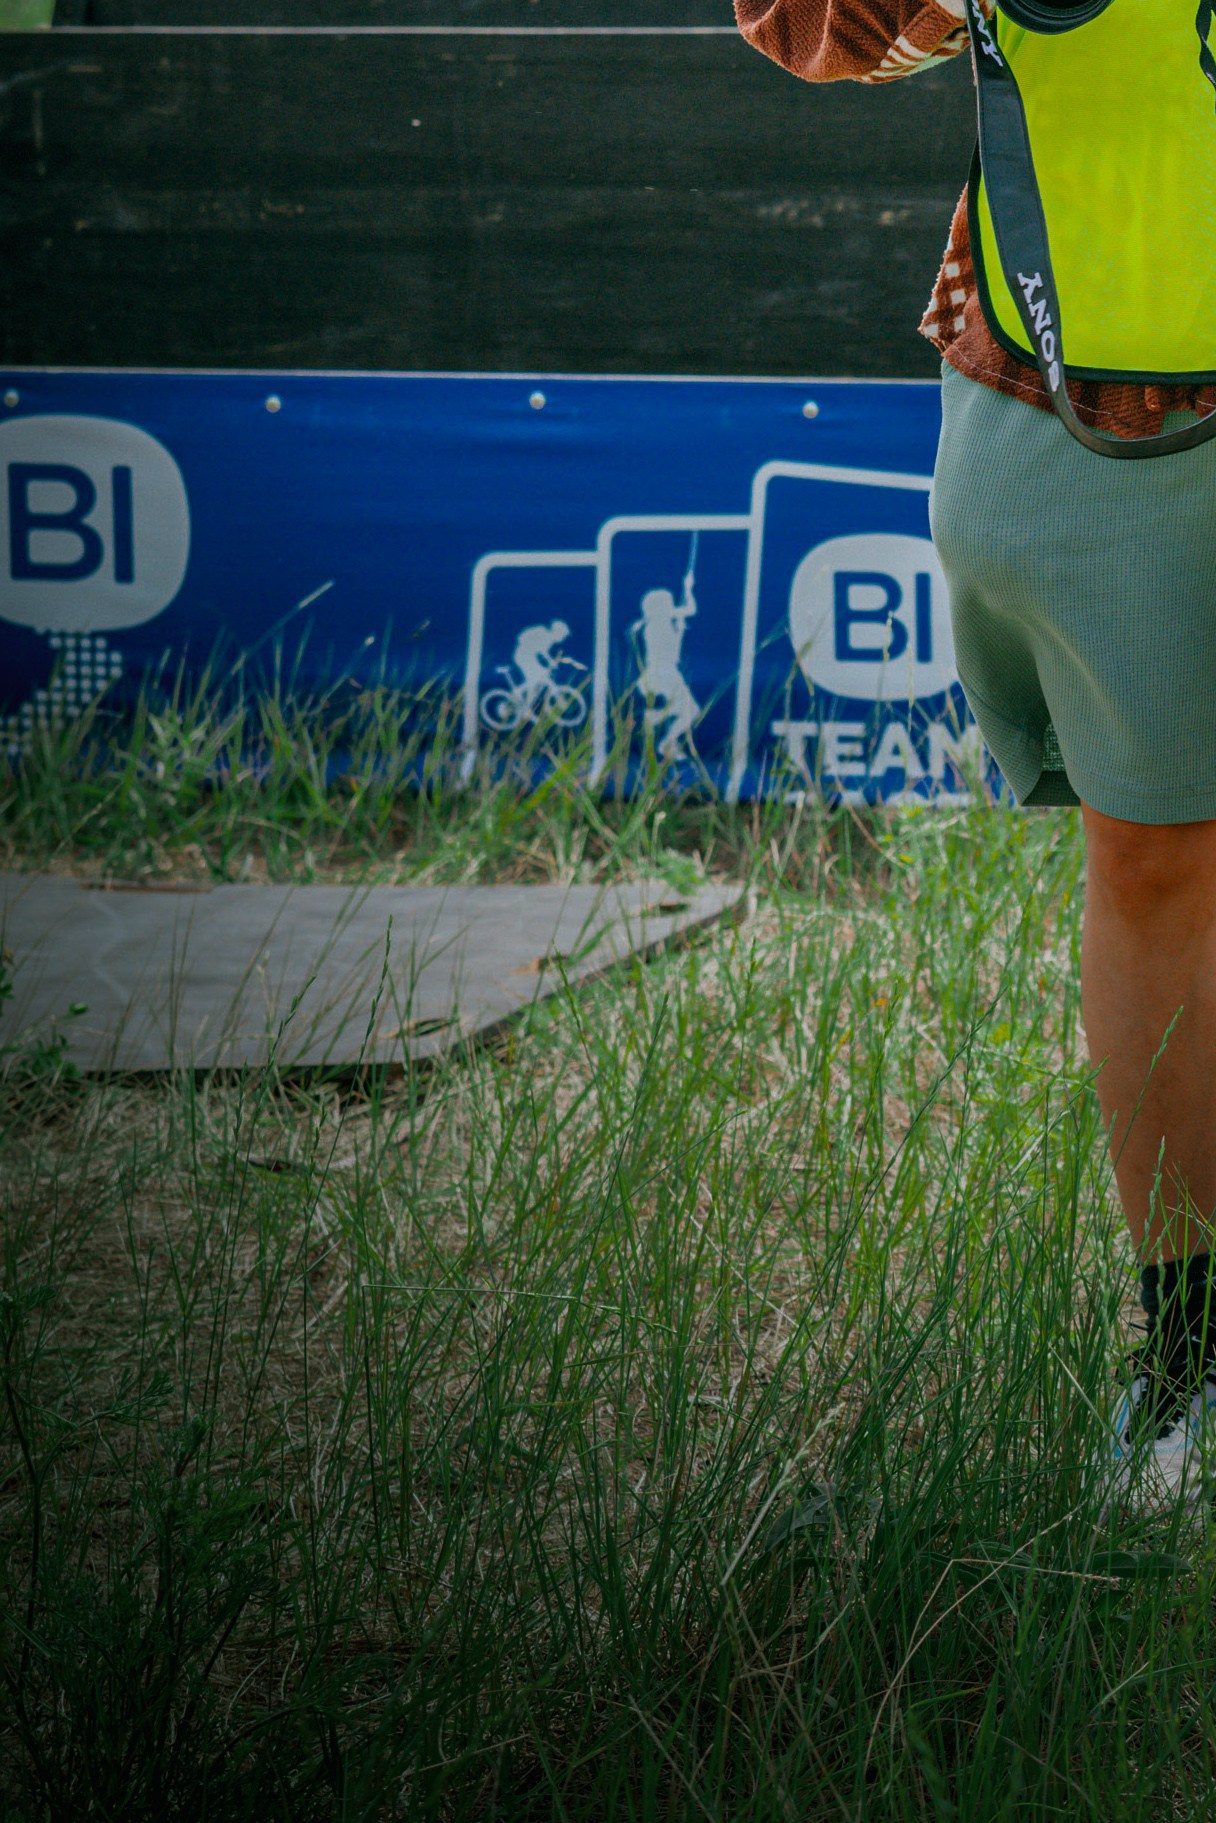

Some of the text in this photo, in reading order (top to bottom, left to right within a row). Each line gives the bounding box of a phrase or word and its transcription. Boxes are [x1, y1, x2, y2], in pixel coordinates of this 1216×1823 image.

[1017, 272, 1060, 393] SONY
[7, 461, 135, 584] BI
[833, 570, 932, 664] BI
[771, 720, 986, 782] TEAM
